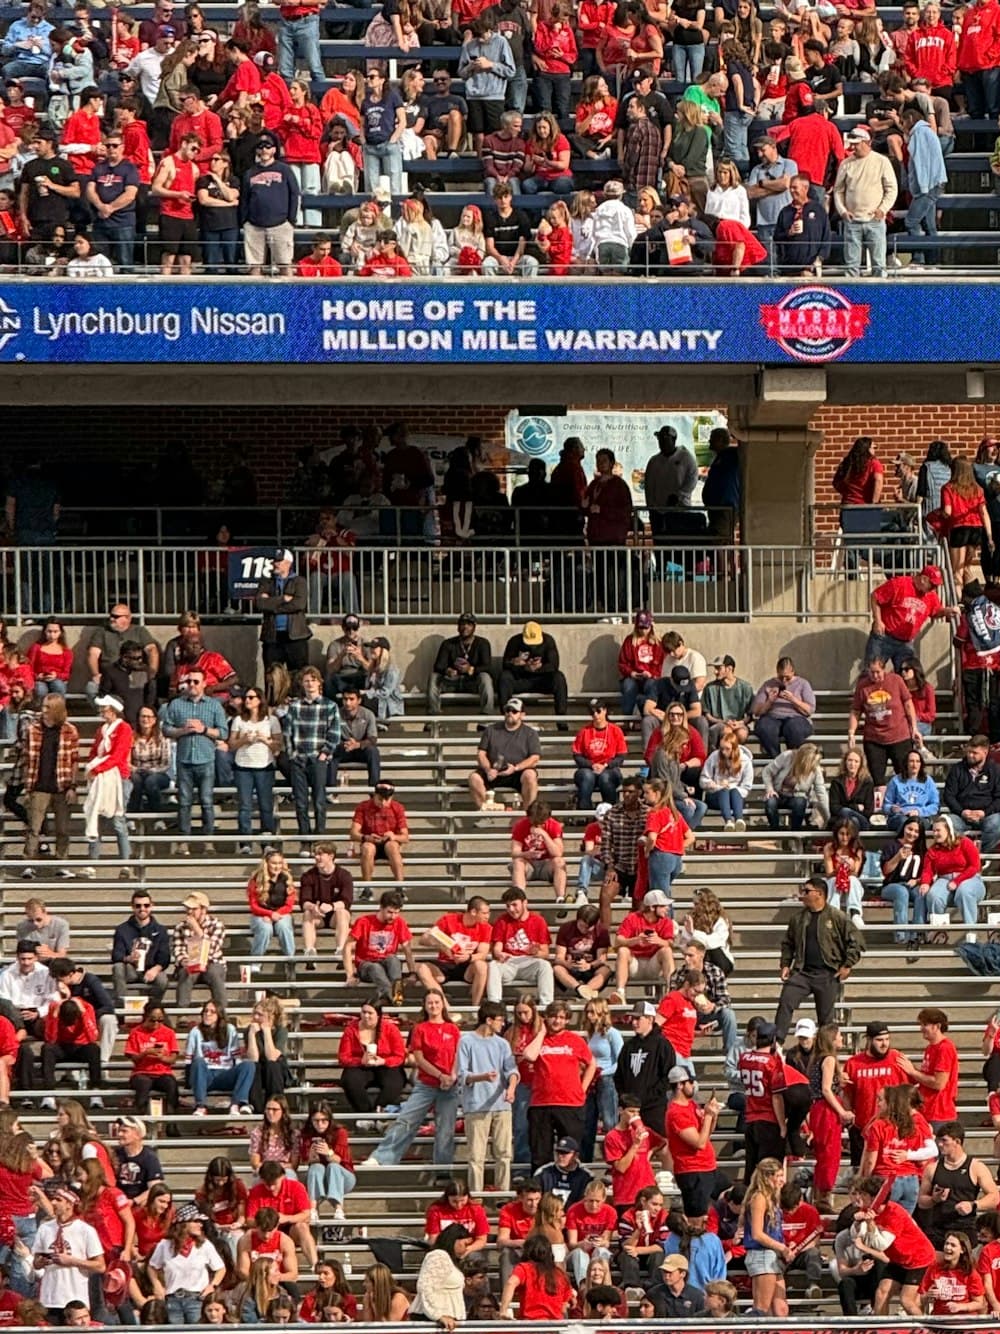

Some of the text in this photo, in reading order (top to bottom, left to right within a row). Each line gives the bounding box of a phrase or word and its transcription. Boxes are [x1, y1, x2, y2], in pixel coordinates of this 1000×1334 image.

[322, 299, 537, 321] HOME OF THE
[33, 306, 181, 341] Lynchburg
[191, 307, 286, 335] Nissan
[322, 329, 723, 351] MILLION MILE WARRANTY
